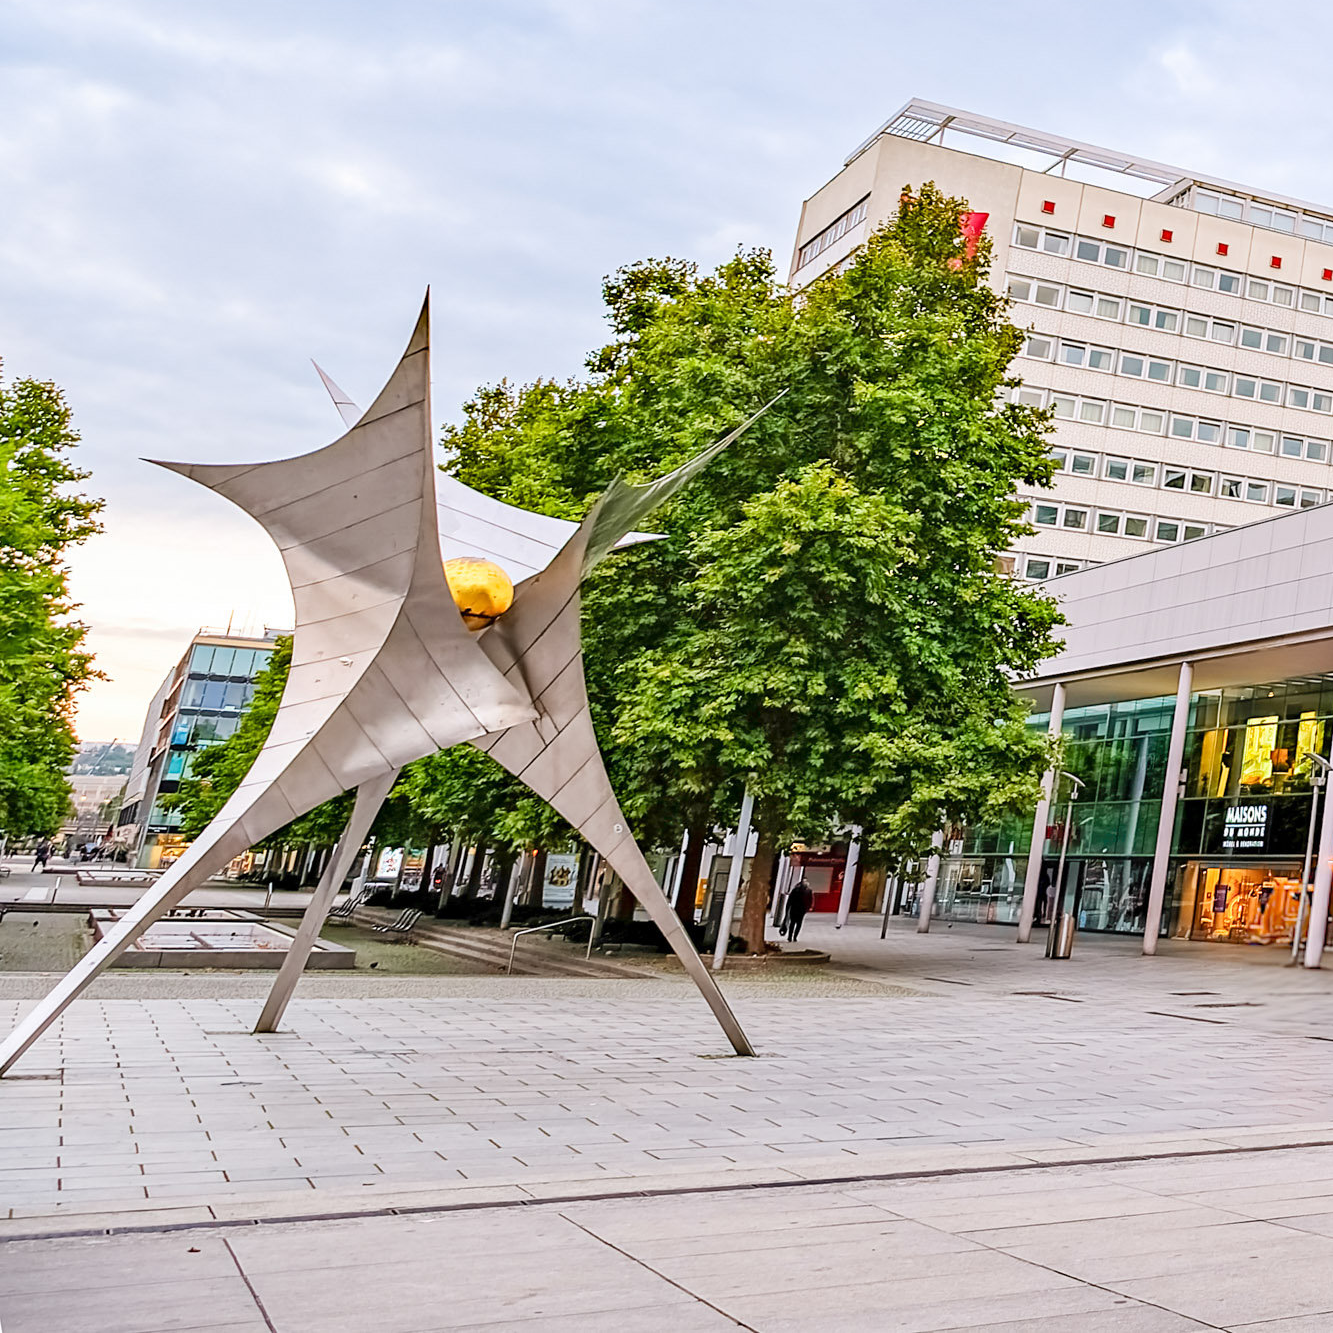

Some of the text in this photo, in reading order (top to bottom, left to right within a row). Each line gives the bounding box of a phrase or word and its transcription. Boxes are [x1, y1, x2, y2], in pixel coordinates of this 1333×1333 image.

[1225, 805, 1267, 823] MAISONS
[1223, 827, 1265, 837] DU MONDE
